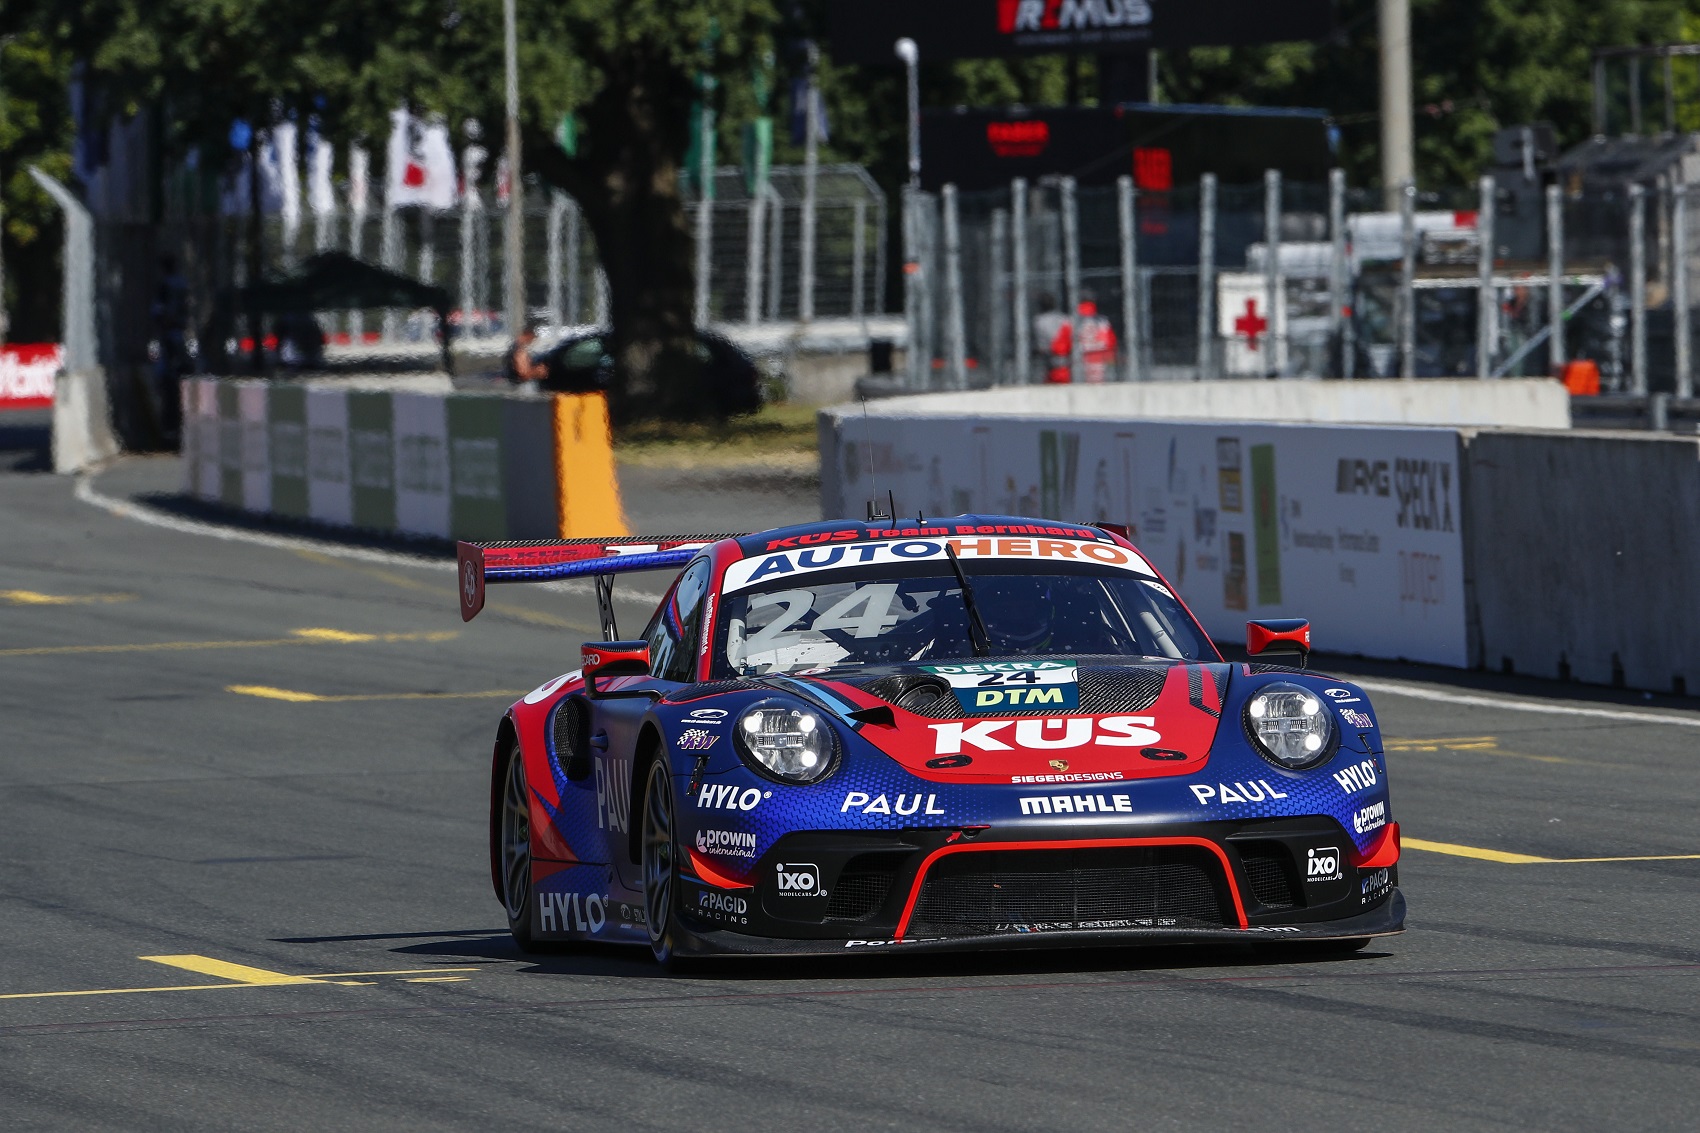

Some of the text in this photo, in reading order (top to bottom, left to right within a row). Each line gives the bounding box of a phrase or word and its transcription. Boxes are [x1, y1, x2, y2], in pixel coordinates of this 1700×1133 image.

[766, 525, 1096, 551] KÜS Team Bernhard
[745, 540, 1128, 584] AUTOHERO
[735, 583, 899, 660] 24
[934, 661, 1068, 674] DEKRA
[977, 671, 1041, 687] 24
[976, 687, 1064, 707] DTM
[927, 716, 1162, 755] KÜS
[1011, 772, 1124, 784] SIEGERDESIGNS
[1188, 779, 1287, 805] PAUL
[840, 791, 945, 816] PAUL
[1019, 794, 1133, 815] MAHLE
[709, 892, 748, 914] PAGID
[698, 909, 748, 925] RACING
